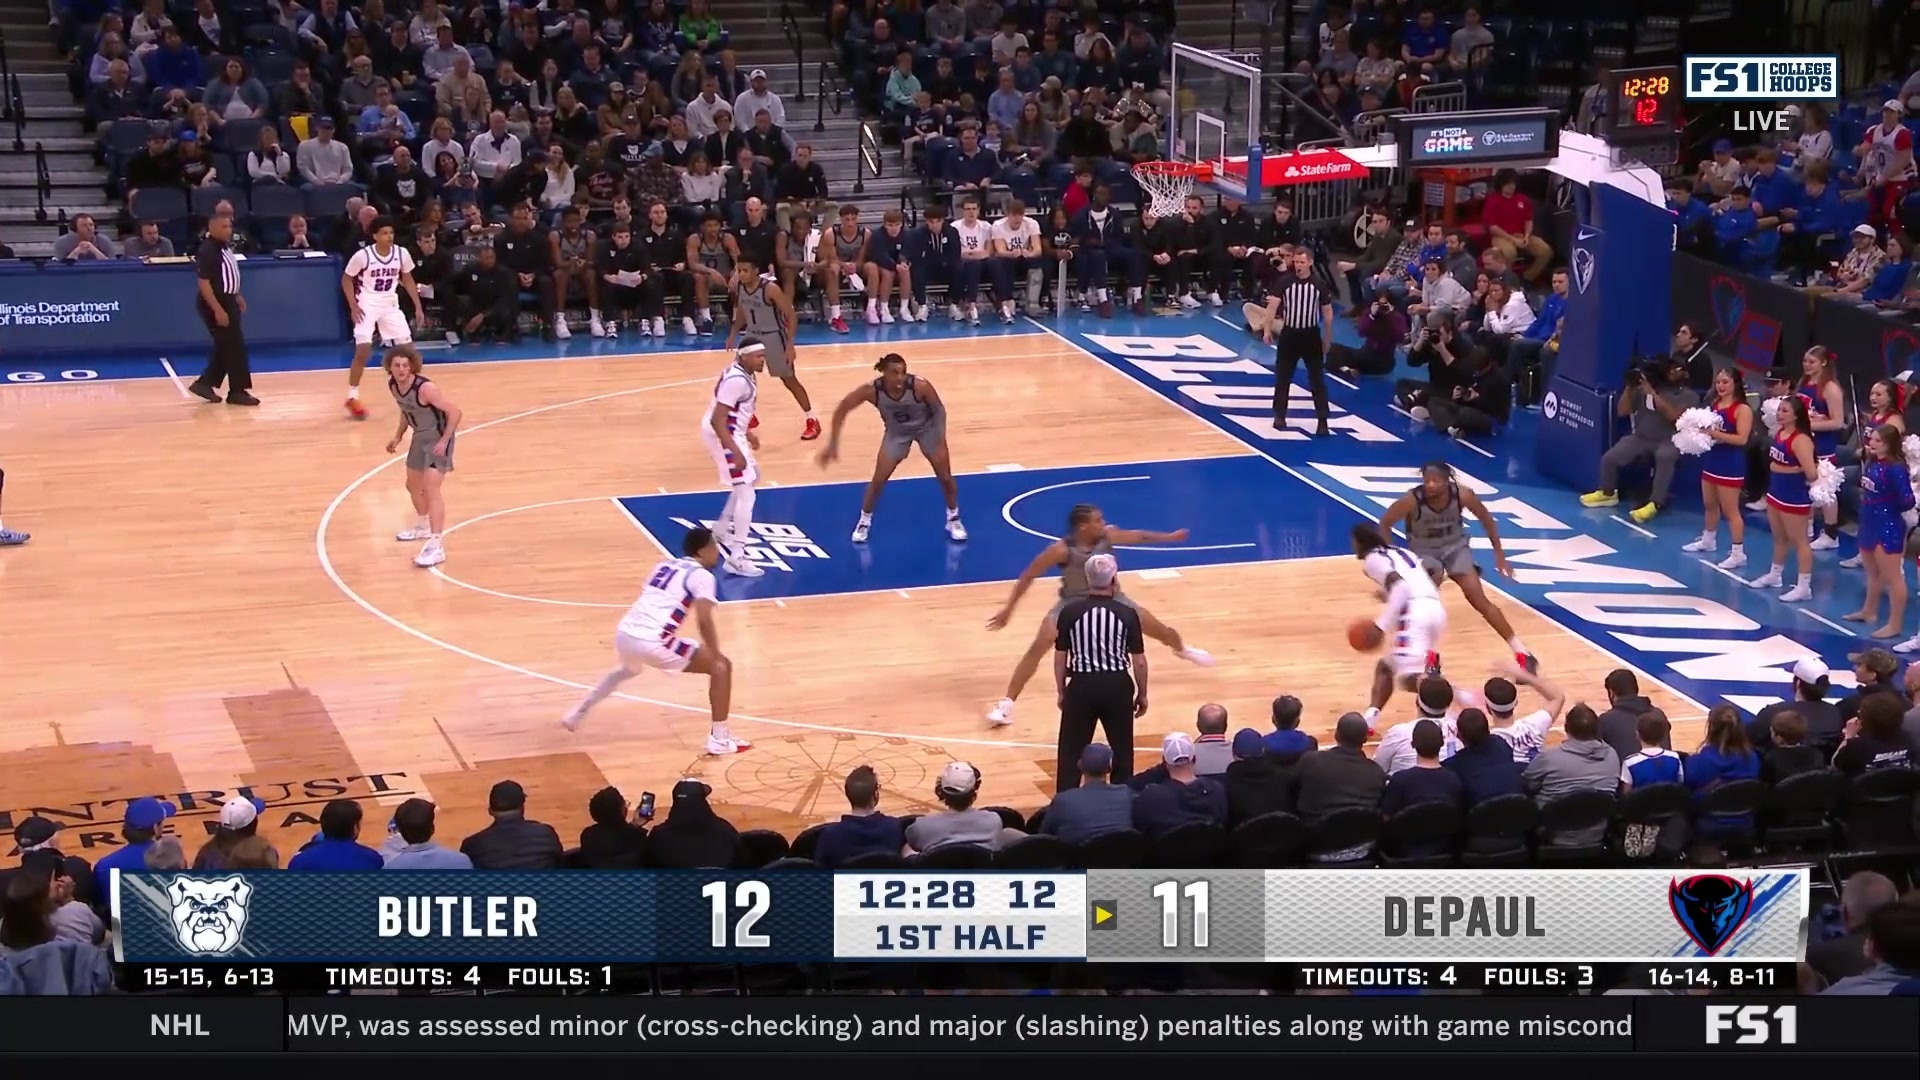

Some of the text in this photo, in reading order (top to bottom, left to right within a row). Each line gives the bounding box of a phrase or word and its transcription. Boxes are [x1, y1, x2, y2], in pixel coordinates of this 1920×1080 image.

[1624, 76, 1670, 97] 12:28
[1636, 98, 1657, 124] 12
[1444, 128, 1461, 137] NOT
[1425, 137, 1474, 152] GAME
[38, 300, 119, 314] Department
[11, 312, 110, 326] Transportation
